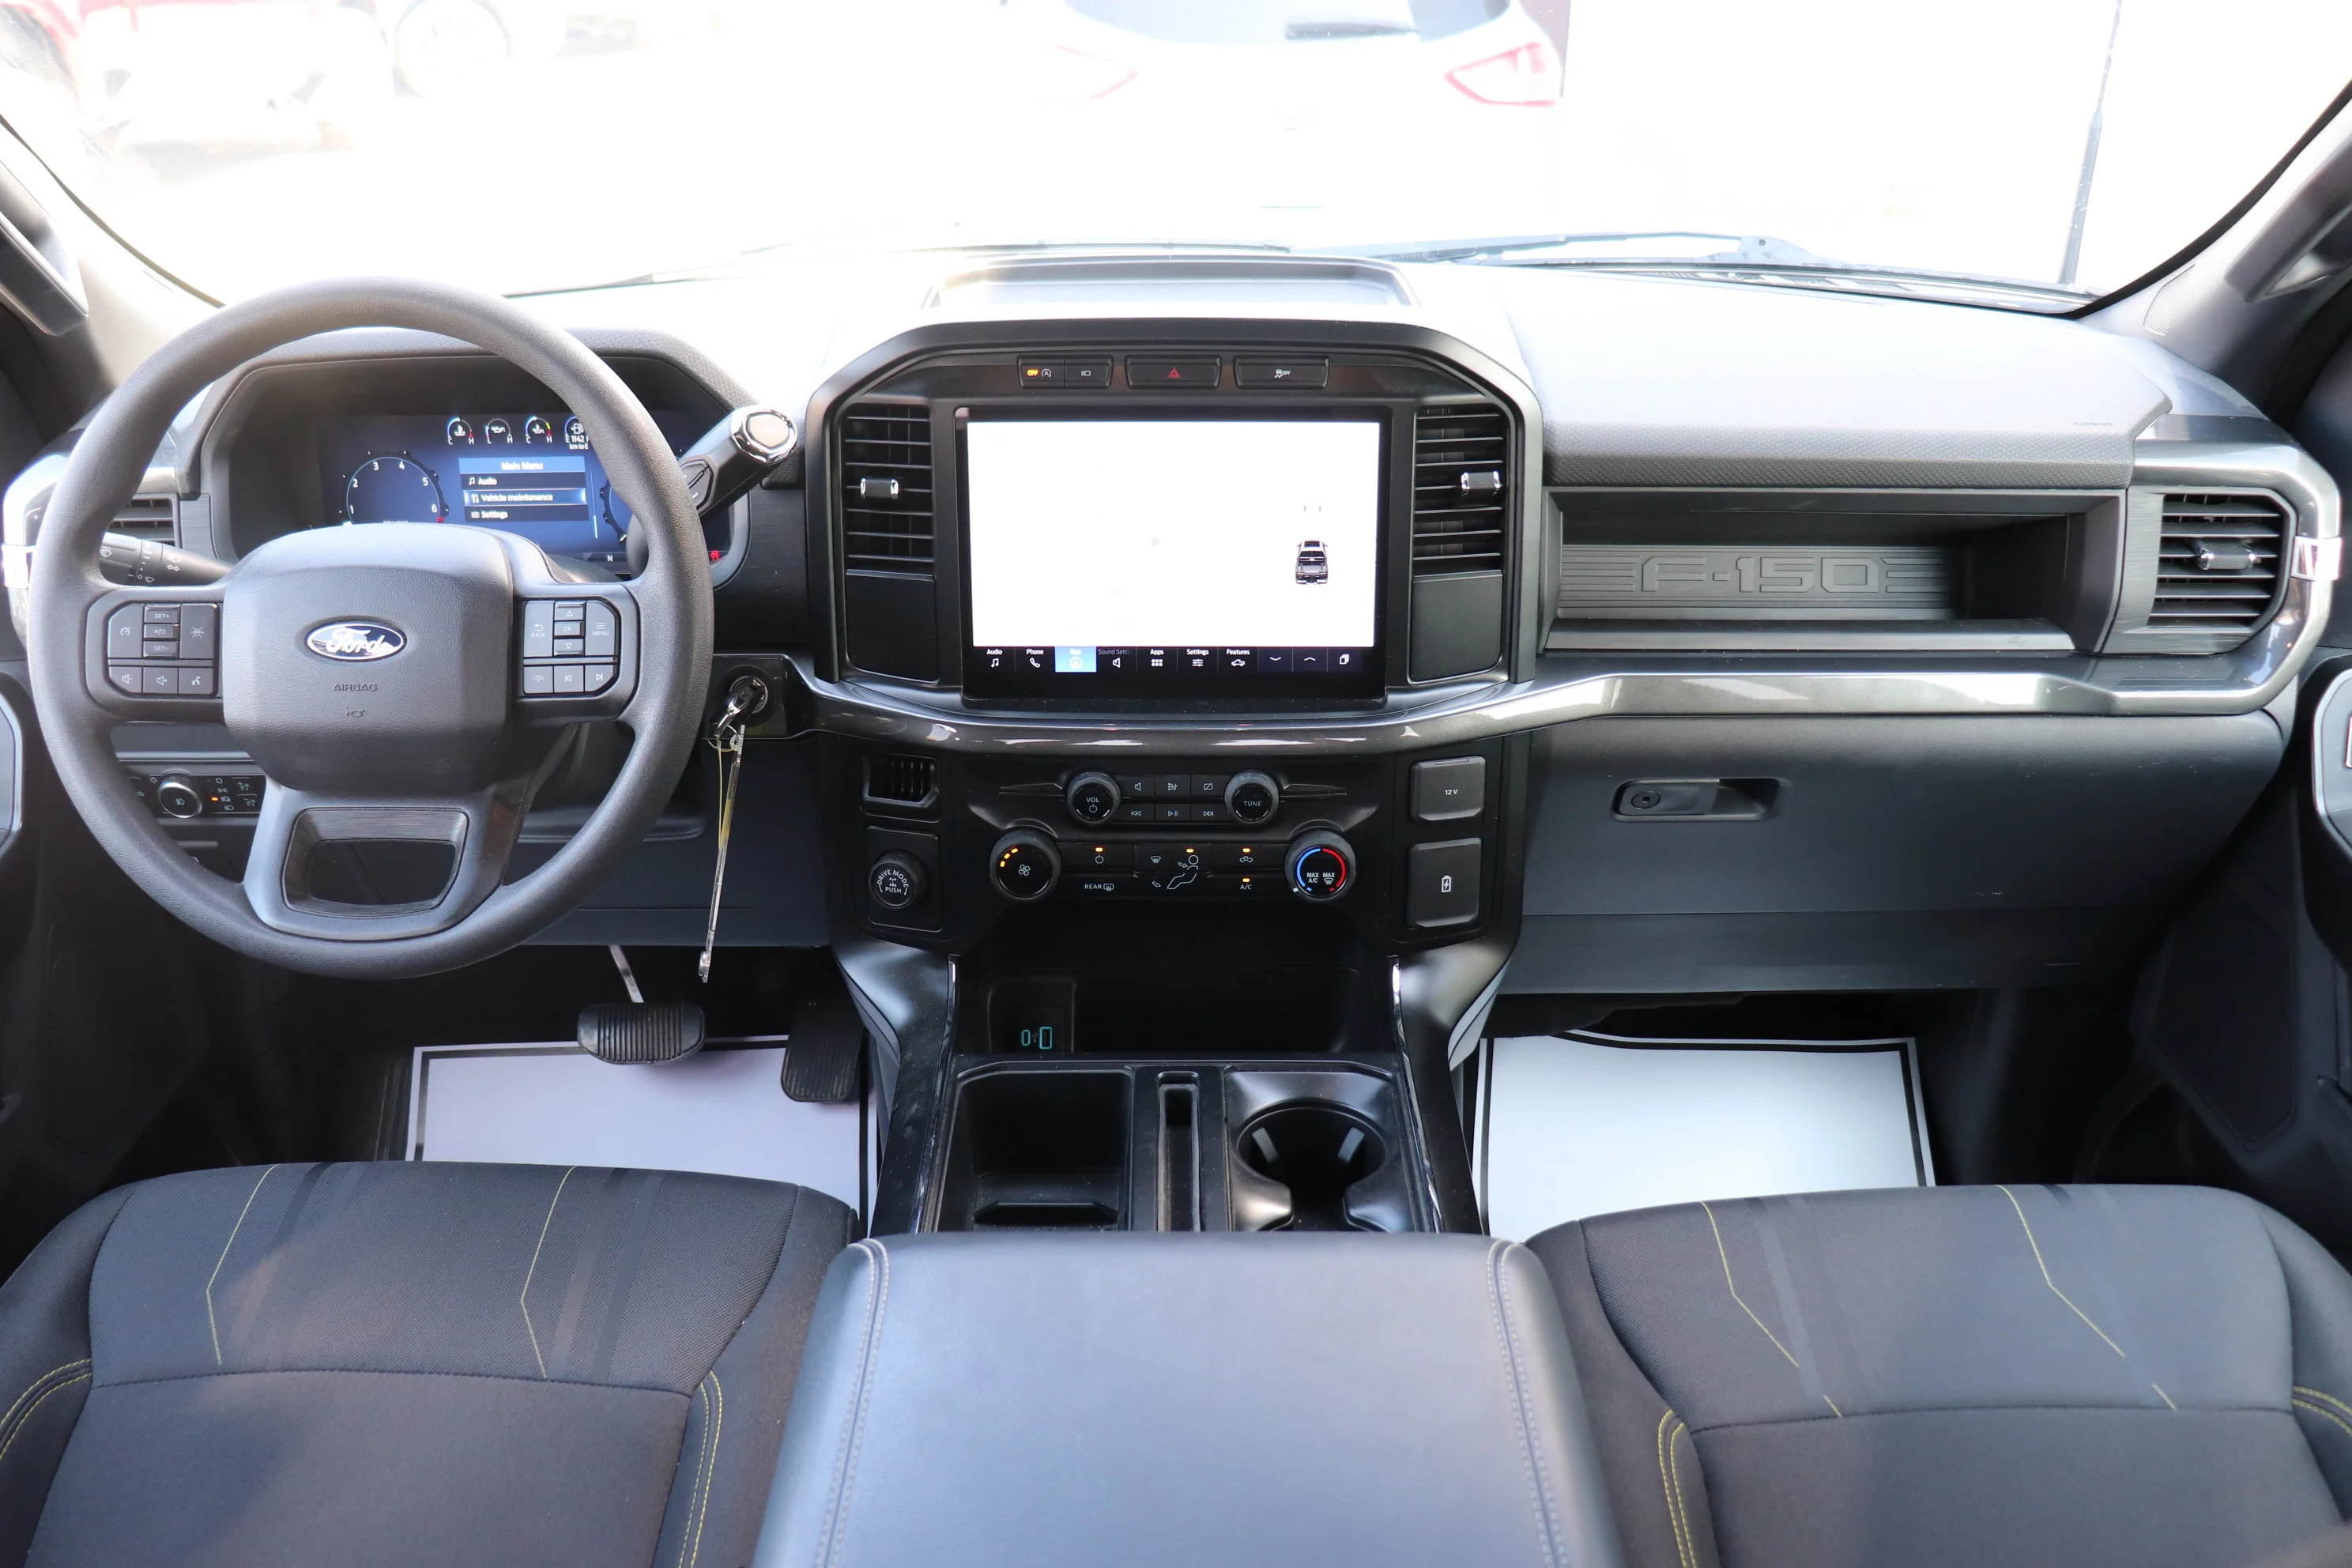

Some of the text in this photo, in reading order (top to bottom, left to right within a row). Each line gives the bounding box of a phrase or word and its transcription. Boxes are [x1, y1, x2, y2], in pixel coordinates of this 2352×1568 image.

[373, 461, 379, 470] 3
[398, 461, 405, 469] 4
[501, 462, 544, 470] Main Menu
[352, 478, 358, 488] 2
[422, 477, 428, 486] 5
[481, 493, 507, 502] Vehicle
[349, 505, 354, 514] 1
[431, 504, 437, 513] 6
[481, 511, 508, 519] Settings
[1641, 556, 1879, 593] F-150
[333, 683, 378, 692] AIRBAG
[876, 869, 909, 888] DRIVE MODE
